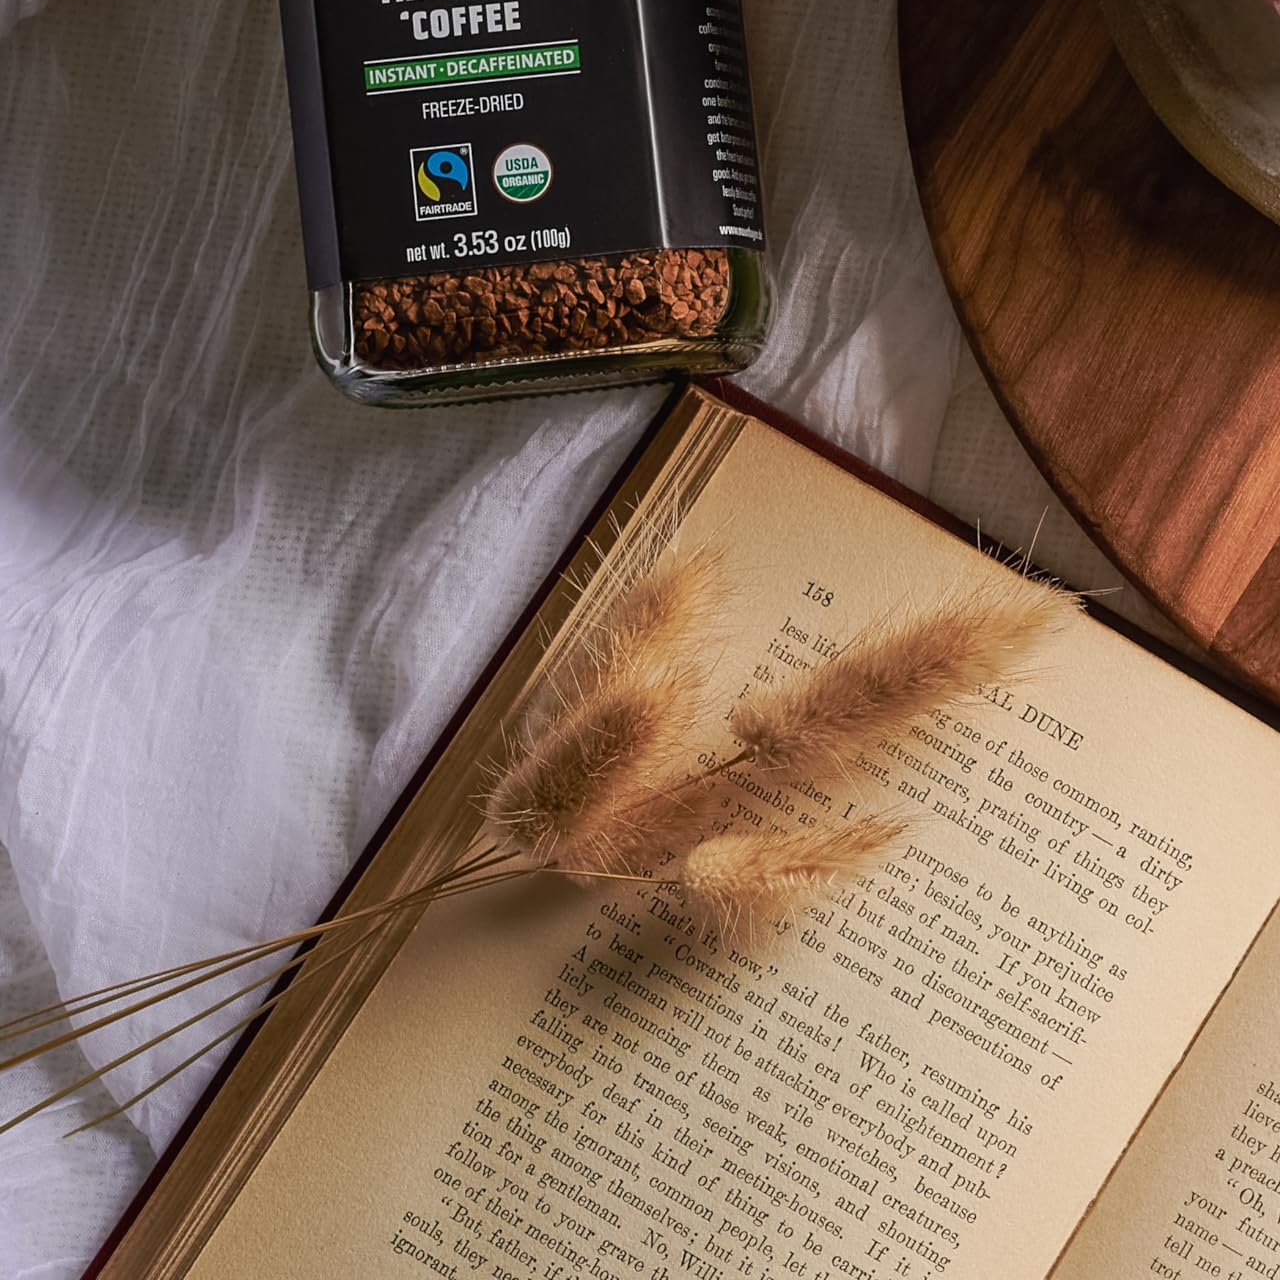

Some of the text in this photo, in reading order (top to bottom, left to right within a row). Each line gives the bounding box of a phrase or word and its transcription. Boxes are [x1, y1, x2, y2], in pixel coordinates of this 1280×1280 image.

[369, 49, 575, 85] INSTANT DECAFFEINATED
[422, 92, 524, 120] FREEZE-DRIED
[502, 173, 545, 188] ORGANIC
[505, 157, 538, 171] USDA
[419, 201, 473, 216] FAIRTRADE
[406, 227, 571, 262] net wt. 3.53 oz (100g)
[801, 581, 1084, 750] 158 DUNE
[876, 734, 1168, 915] adventurers, prating of things they
[953, 721, 1192, 871] one of those common, ranting,
[901, 844, 1127, 980] purpose to be anything as
[700, 927, 727, 955] it,
[780, 982, 818, 1008] said
[823, 1003, 849, 1027] the
[856, 1023, 909, 1068] father,
[920, 1063, 1000, 1119] resuming
[1005, 1108, 1032, 1135] his
[570, 944, 587, 963] A
[586, 958, 667, 1011] gentleman
[672, 1005, 704, 1032] will
[702, 1025, 731, 1048] not
[733, 1037, 752, 1061] be
[754, 1056, 830, 1110] attacking
[831, 1102, 916, 1159] everybody
[917, 1154, 953, 1179] and
[516, 1034, 910, 1276] everybody deaf in their meeting-houses. If it
[1214, 1148, 1225, 1160] a
[1230, 1124, 1267, 1155] they
[444, 1141, 644, 1272] follow you to your grave
[475, 1097, 507, 1122] the
[505, 1116, 547, 1154] thing
[550, 1147, 603, 1188] among
[703, 1233, 733, 1263] but
[736, 1255, 753, 1275] it
[1183, 1191, 1227, 1220] your
[402, 1210, 488, 1270] souls, they
[1163, 1234, 1220, 1277] tell me
[1173, 1212, 1280, 1278] name and
